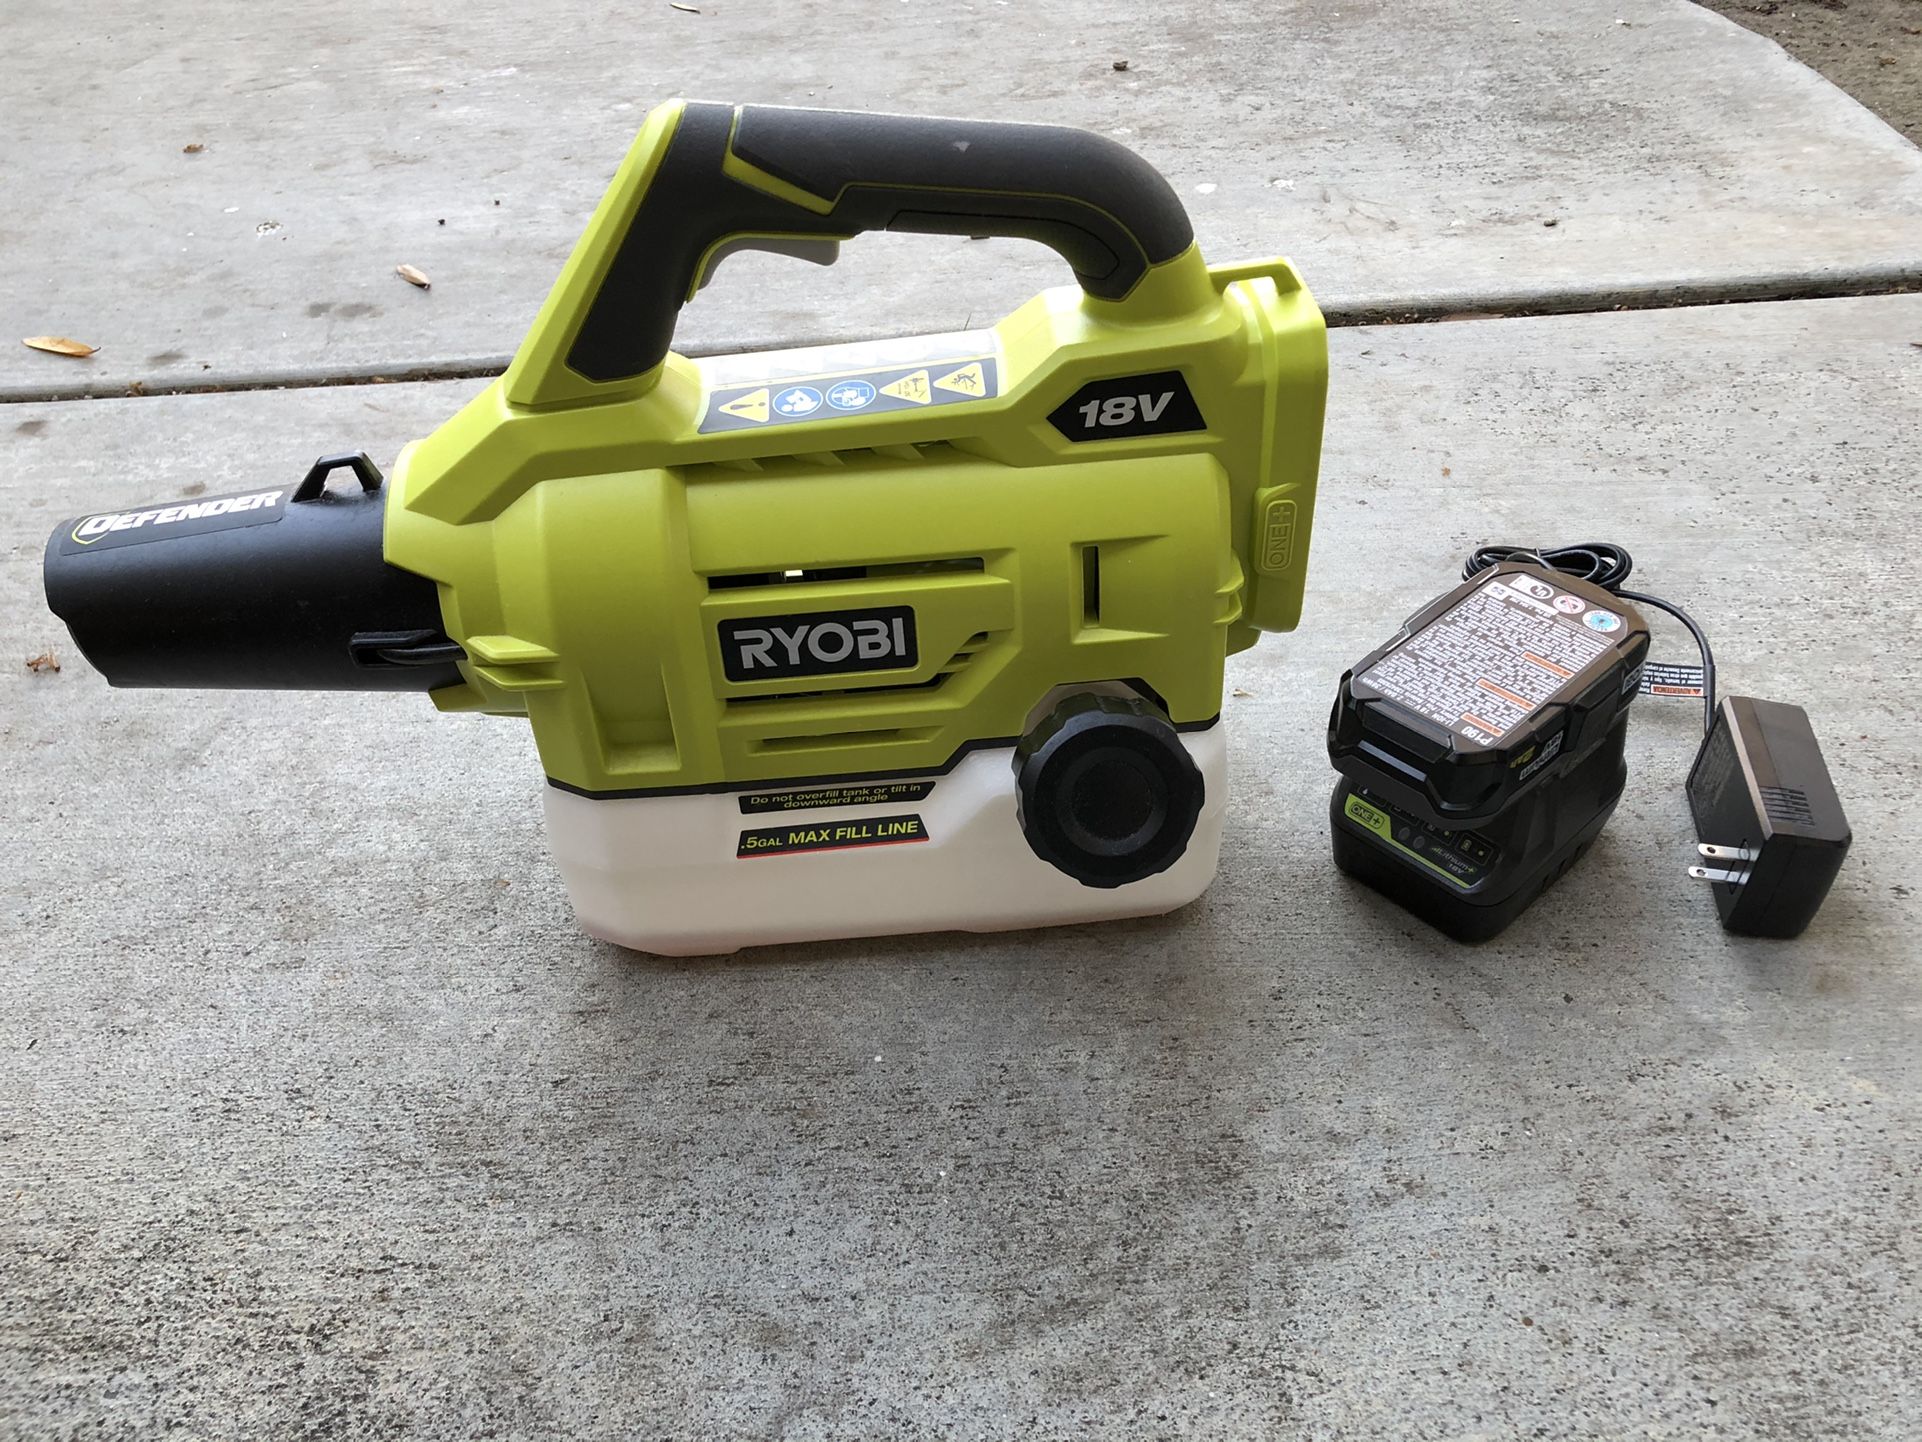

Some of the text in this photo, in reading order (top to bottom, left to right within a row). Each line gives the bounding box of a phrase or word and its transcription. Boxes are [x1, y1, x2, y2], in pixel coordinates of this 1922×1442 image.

[1079, 392, 1175, 428] 18V
[78, 491, 283, 536] DEFENDER
[1269, 506, 1291, 565] ONE+
[733, 617, 906, 669] RYOBI
[1459, 725, 1494, 745] P190
[751, 797, 768, 805] Do
[772, 794, 792, 803] not
[797, 791, 839, 801] overfill
[843, 788, 869, 797] tank
[891, 785, 907, 793] tilt
[910, 784, 921, 792] in
[784, 794, 888, 808] downward angle
[741, 821, 919, 849] .5GAL MAX FILL LINE
